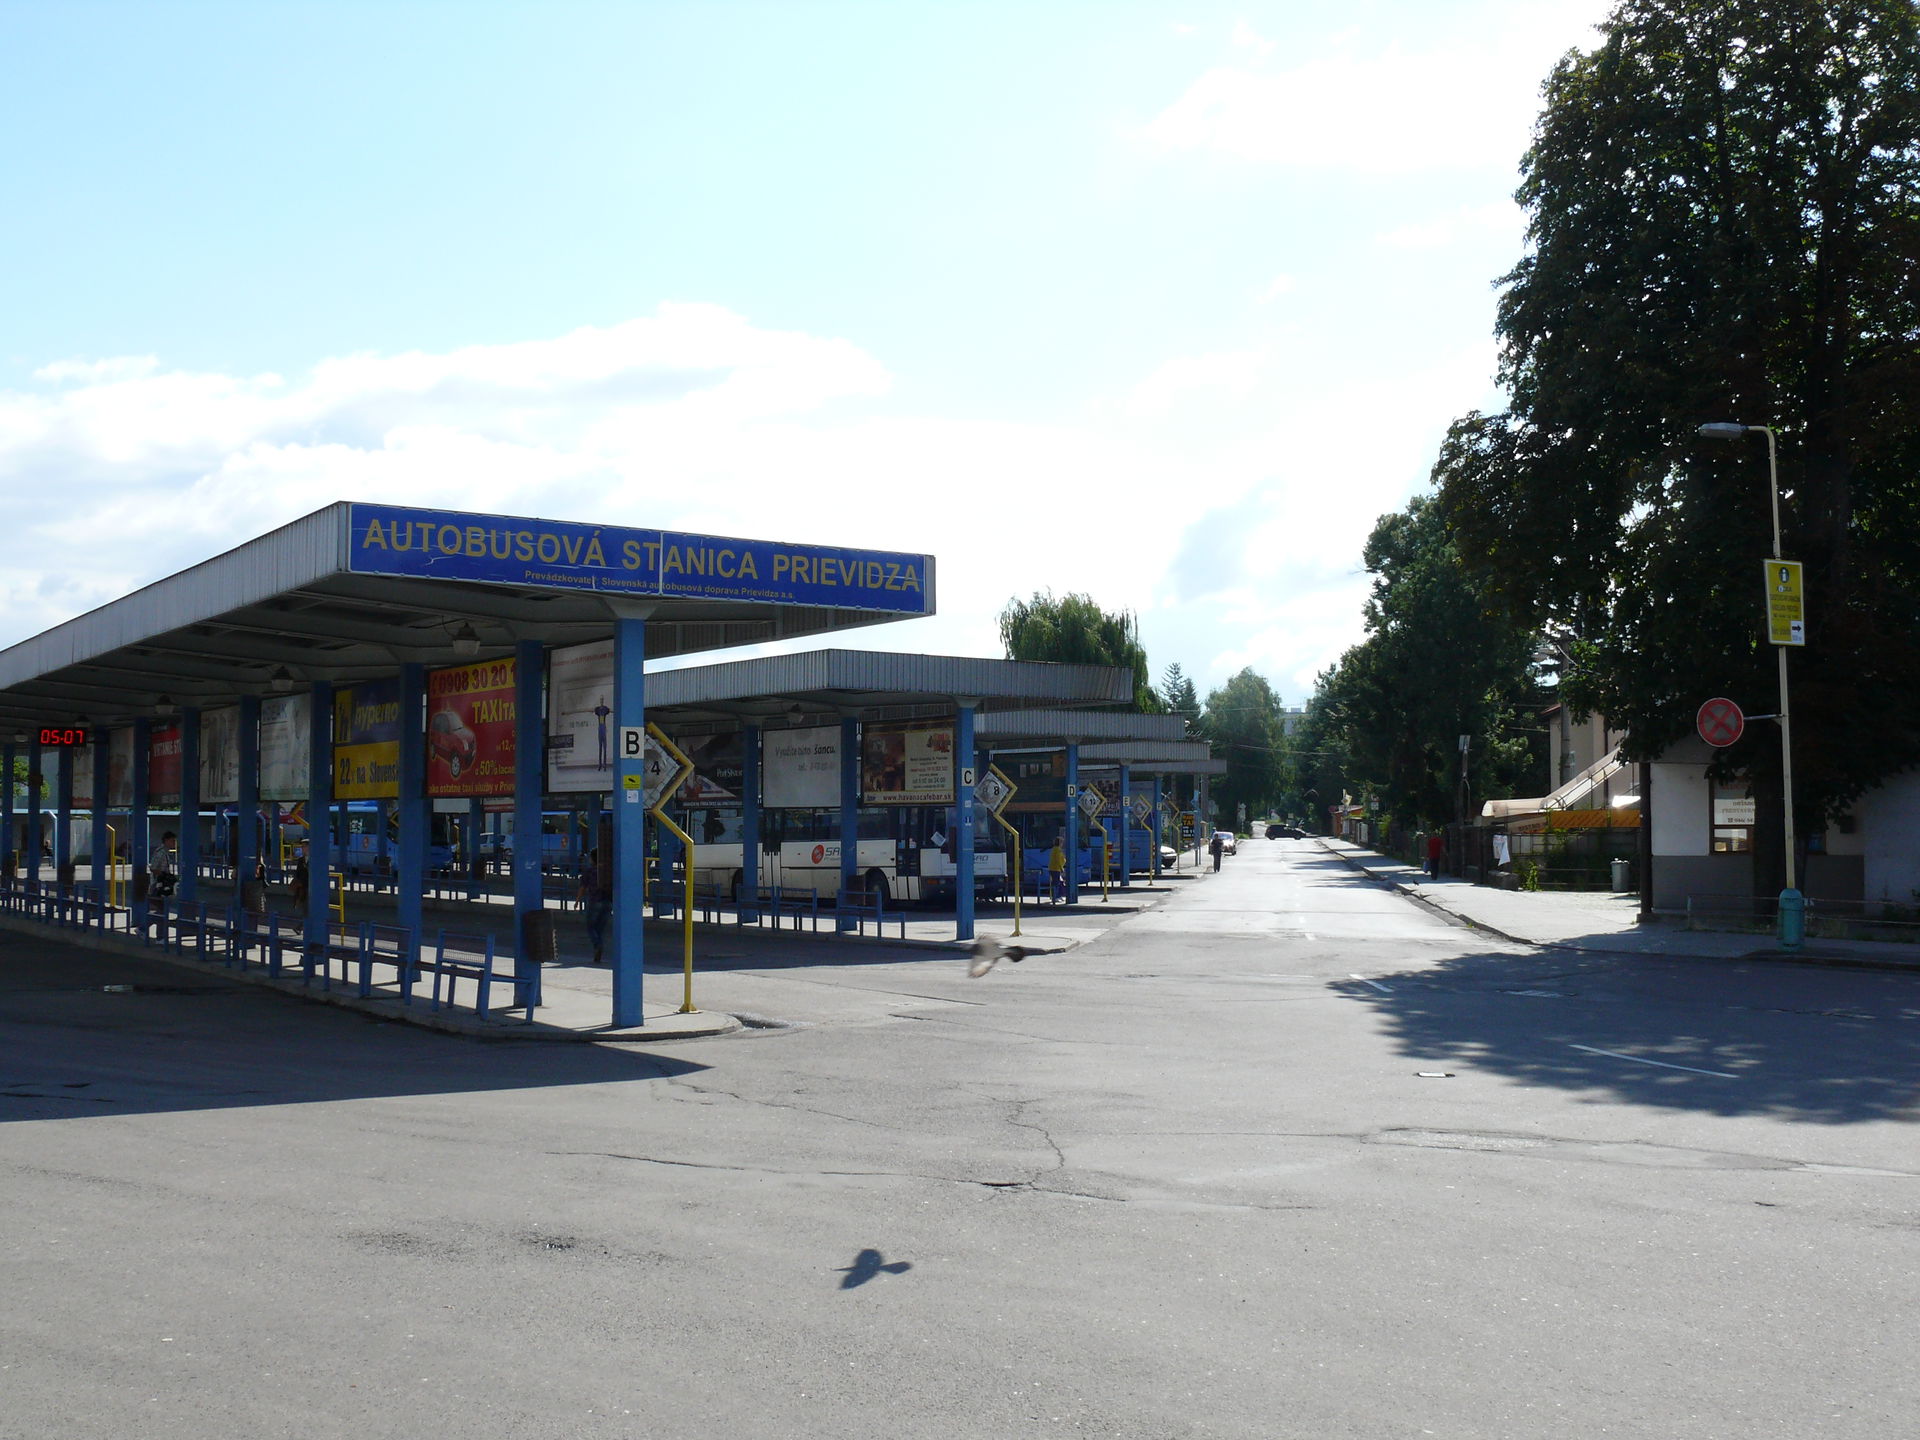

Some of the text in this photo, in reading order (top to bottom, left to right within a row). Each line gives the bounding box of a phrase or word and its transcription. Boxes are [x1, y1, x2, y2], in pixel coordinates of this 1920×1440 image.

[362, 517, 919, 593] AUTOBUSOVÁ STANICA PRIEVIDZA
[601, 577, 647, 590] Slovenská
[704, 584, 739, 595] doprava
[741, 587, 779, 599] Prievidza
[439, 671, 469, 693] 0908
[472, 668, 488, 689] 30
[491, 663, 507, 686] 20
[626, 731, 639, 755] B
[651, 761, 661, 775] 4
[964, 770, 972, 784] C
[1070, 786, 1074, 796] D
